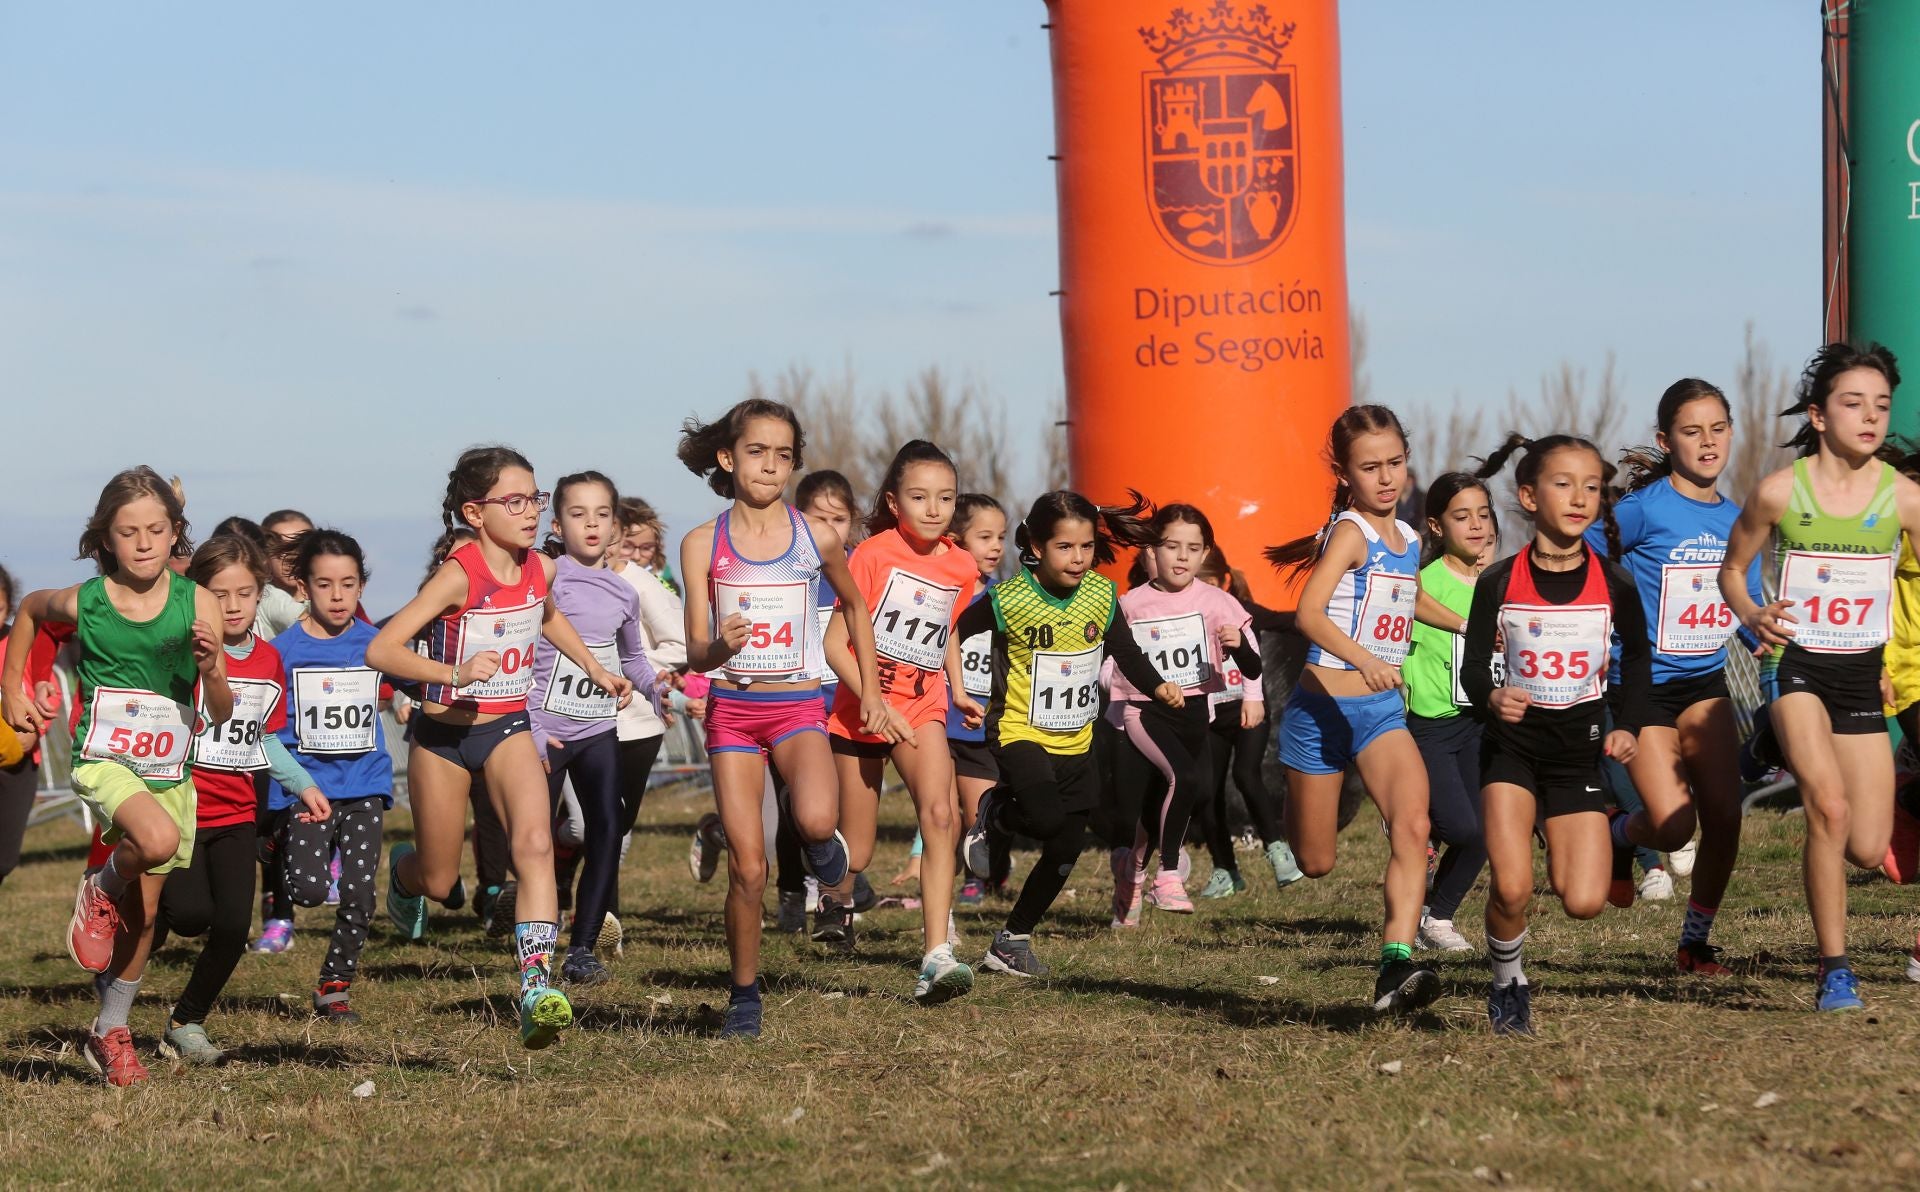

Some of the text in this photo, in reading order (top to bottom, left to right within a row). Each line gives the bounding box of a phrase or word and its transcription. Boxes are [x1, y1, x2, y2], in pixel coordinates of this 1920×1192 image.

[1134, 279, 1321, 327] Diputación
[1135, 328, 1324, 372] de Segovia
[1811, 542, 1869, 554] GRANJA
[752, 596, 783, 604] Diputación
[761, 603, 783, 611] Segovia
[1803, 595, 1874, 625] 167
[884, 609, 948, 649] 1170
[1373, 614, 1414, 644] 880
[1543, 621, 1578, 631] Diputación
[1678, 602, 1732, 629] 445
[741, 622, 794, 648] 54
[1024, 623, 1054, 651] 20
[1670, 641, 1718, 649] CANTIMPALOS
[500, 642, 535, 675] 04
[727, 660, 798, 669] ANTIMPALOS 2025
[757, 653, 791, 661] NACIONAL
[961, 648, 992, 675] 85
[1518, 650, 1590, 680] 335
[466, 686, 522, 696] CANTIMPALOS
[558, 674, 614, 699] 104
[1222, 669, 1243, 686] 8
[1040, 680, 1100, 710] 1183
[305, 703, 374, 730] 1502
[107, 727, 174, 758] 580
